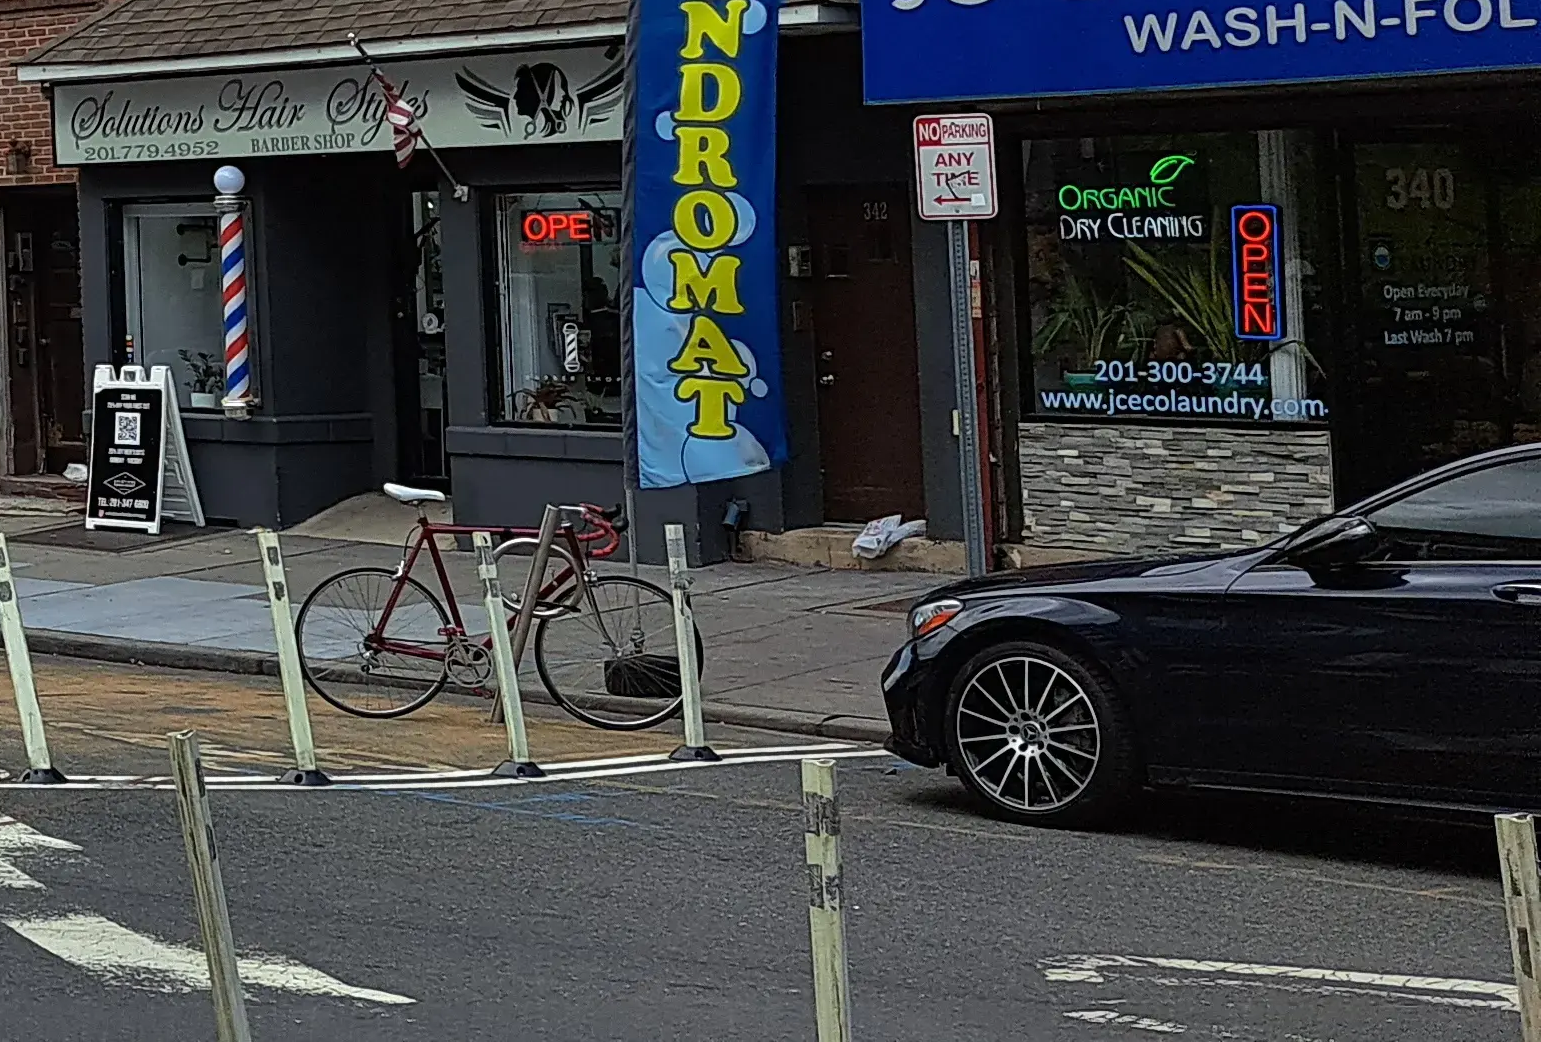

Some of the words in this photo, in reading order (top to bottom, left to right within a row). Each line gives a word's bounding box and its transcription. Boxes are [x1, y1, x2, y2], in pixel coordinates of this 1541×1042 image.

[71, 89, 205, 149] Solutions
[213, 78, 306, 133] Hair
[918, 122, 941, 142] NO
[941, 122, 987, 138] PARKING
[84, 140, 220, 161] 201.779.4952
[251, 134, 313, 154] BARBER
[314, 132, 355, 151] SHOP
[934, 151, 975, 167] ANY
[1059, 185, 1176, 210] ORGANIC
[1385, 167, 1455, 209] 340
[863, 201, 888, 220] 342
[1060, 215, 1101, 240] DRY
[1107, 213, 1203, 239] CLEANING
[1238, 211, 1272, 333] OPEN
[1383, 285, 1415, 300] Open
[1418, 283, 1470, 299] Everyday
[1394, 308, 1402, 322] 7
[1404, 310, 1423, 321] am
[1432, 305, 1439, 321] 9
[1442, 309, 1462, 323] pm
[1384, 330, 1408, 346] Last
[1410, 328, 1443, 344] Wash
[1444, 328, 1452, 343] 7
[1455, 330, 1474, 346] pm
[1094, 360, 1264, 384] 201-300-3744
